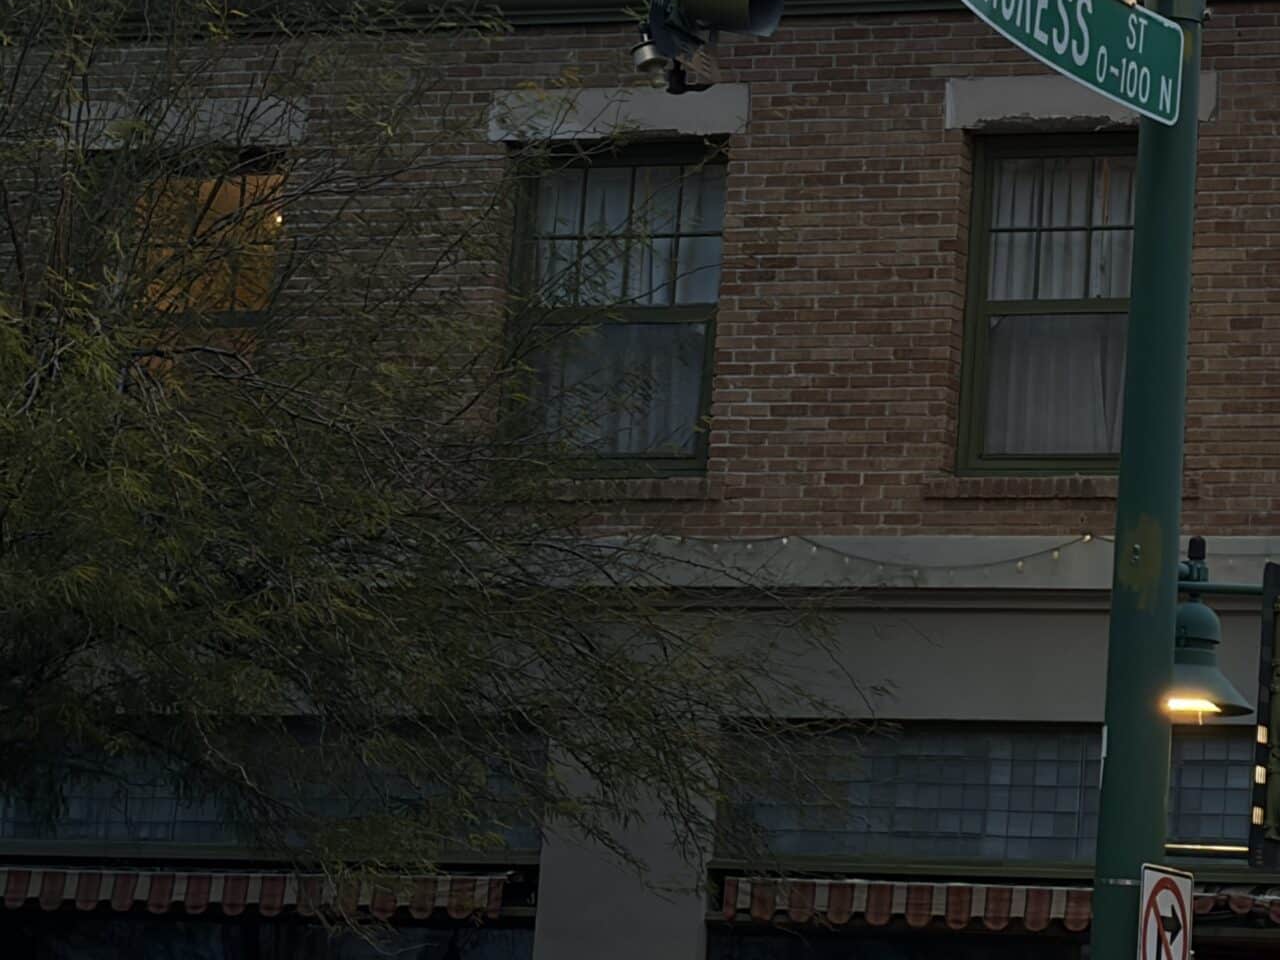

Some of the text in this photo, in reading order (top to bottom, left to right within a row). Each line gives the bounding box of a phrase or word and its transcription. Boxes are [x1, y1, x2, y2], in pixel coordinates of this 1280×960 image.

[1126, 13, 1148, 54] ST
[1096, 45, 1173, 114] 0-100 N
